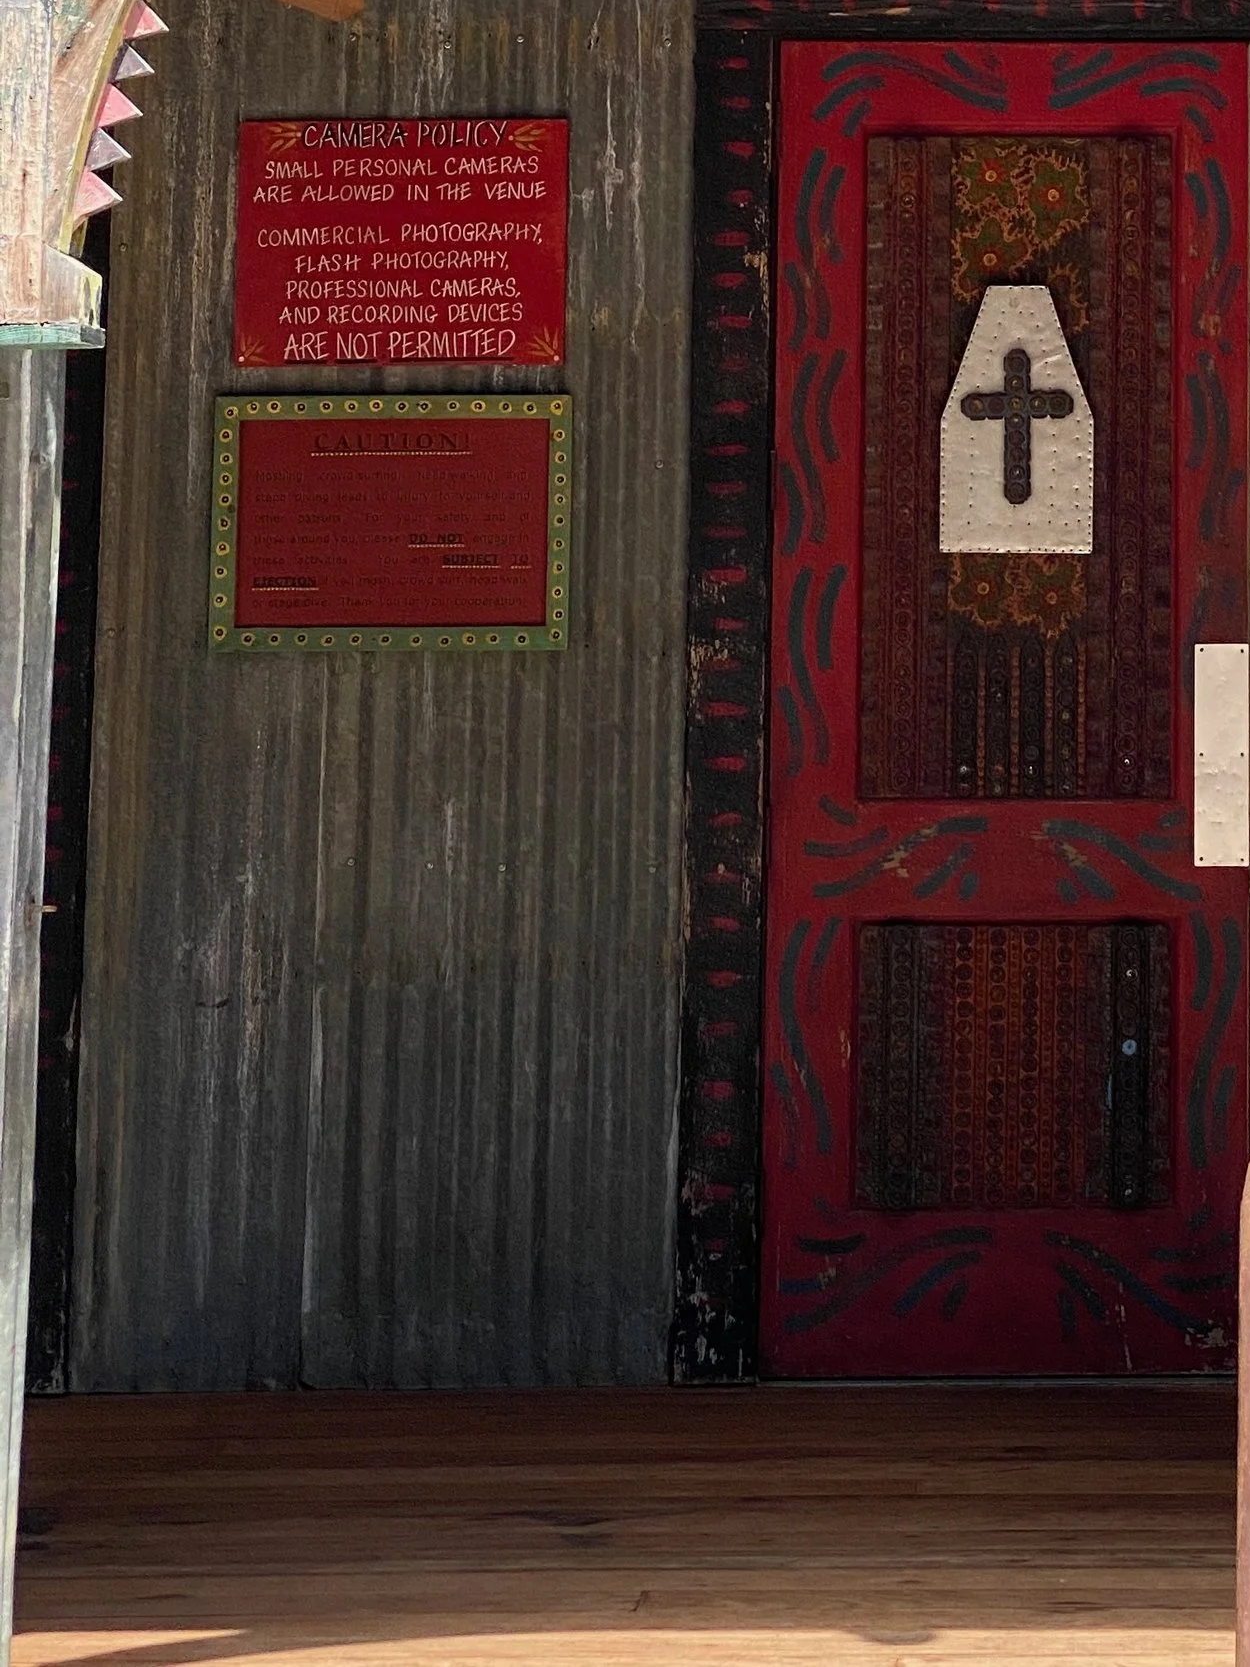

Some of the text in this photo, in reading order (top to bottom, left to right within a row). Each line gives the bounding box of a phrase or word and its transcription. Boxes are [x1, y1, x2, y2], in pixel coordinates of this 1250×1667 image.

[304, 120, 510, 149] CAMERA POLICY
[264, 155, 539, 180] SMALL PERSONAL CAMERAS
[252, 180, 547, 204] ARE ALLOWED IN THE VENUE
[257, 221, 543, 248] COMMERCIAL PHOTOGRAPHY,
[294, 249, 510, 274] FLASH PHOTOGRAPHY,
[285, 276, 521, 300] PROFESSIONAL CAMERAS,
[278, 302, 524, 325] AND RECORDING DEVICES
[283, 327, 516, 361] ARE NOT PERMITTED
[313, 432, 472, 451] CAUTION!
[442, 553, 499, 566] SUBJECT
[252, 576, 317, 588] EJECTION
